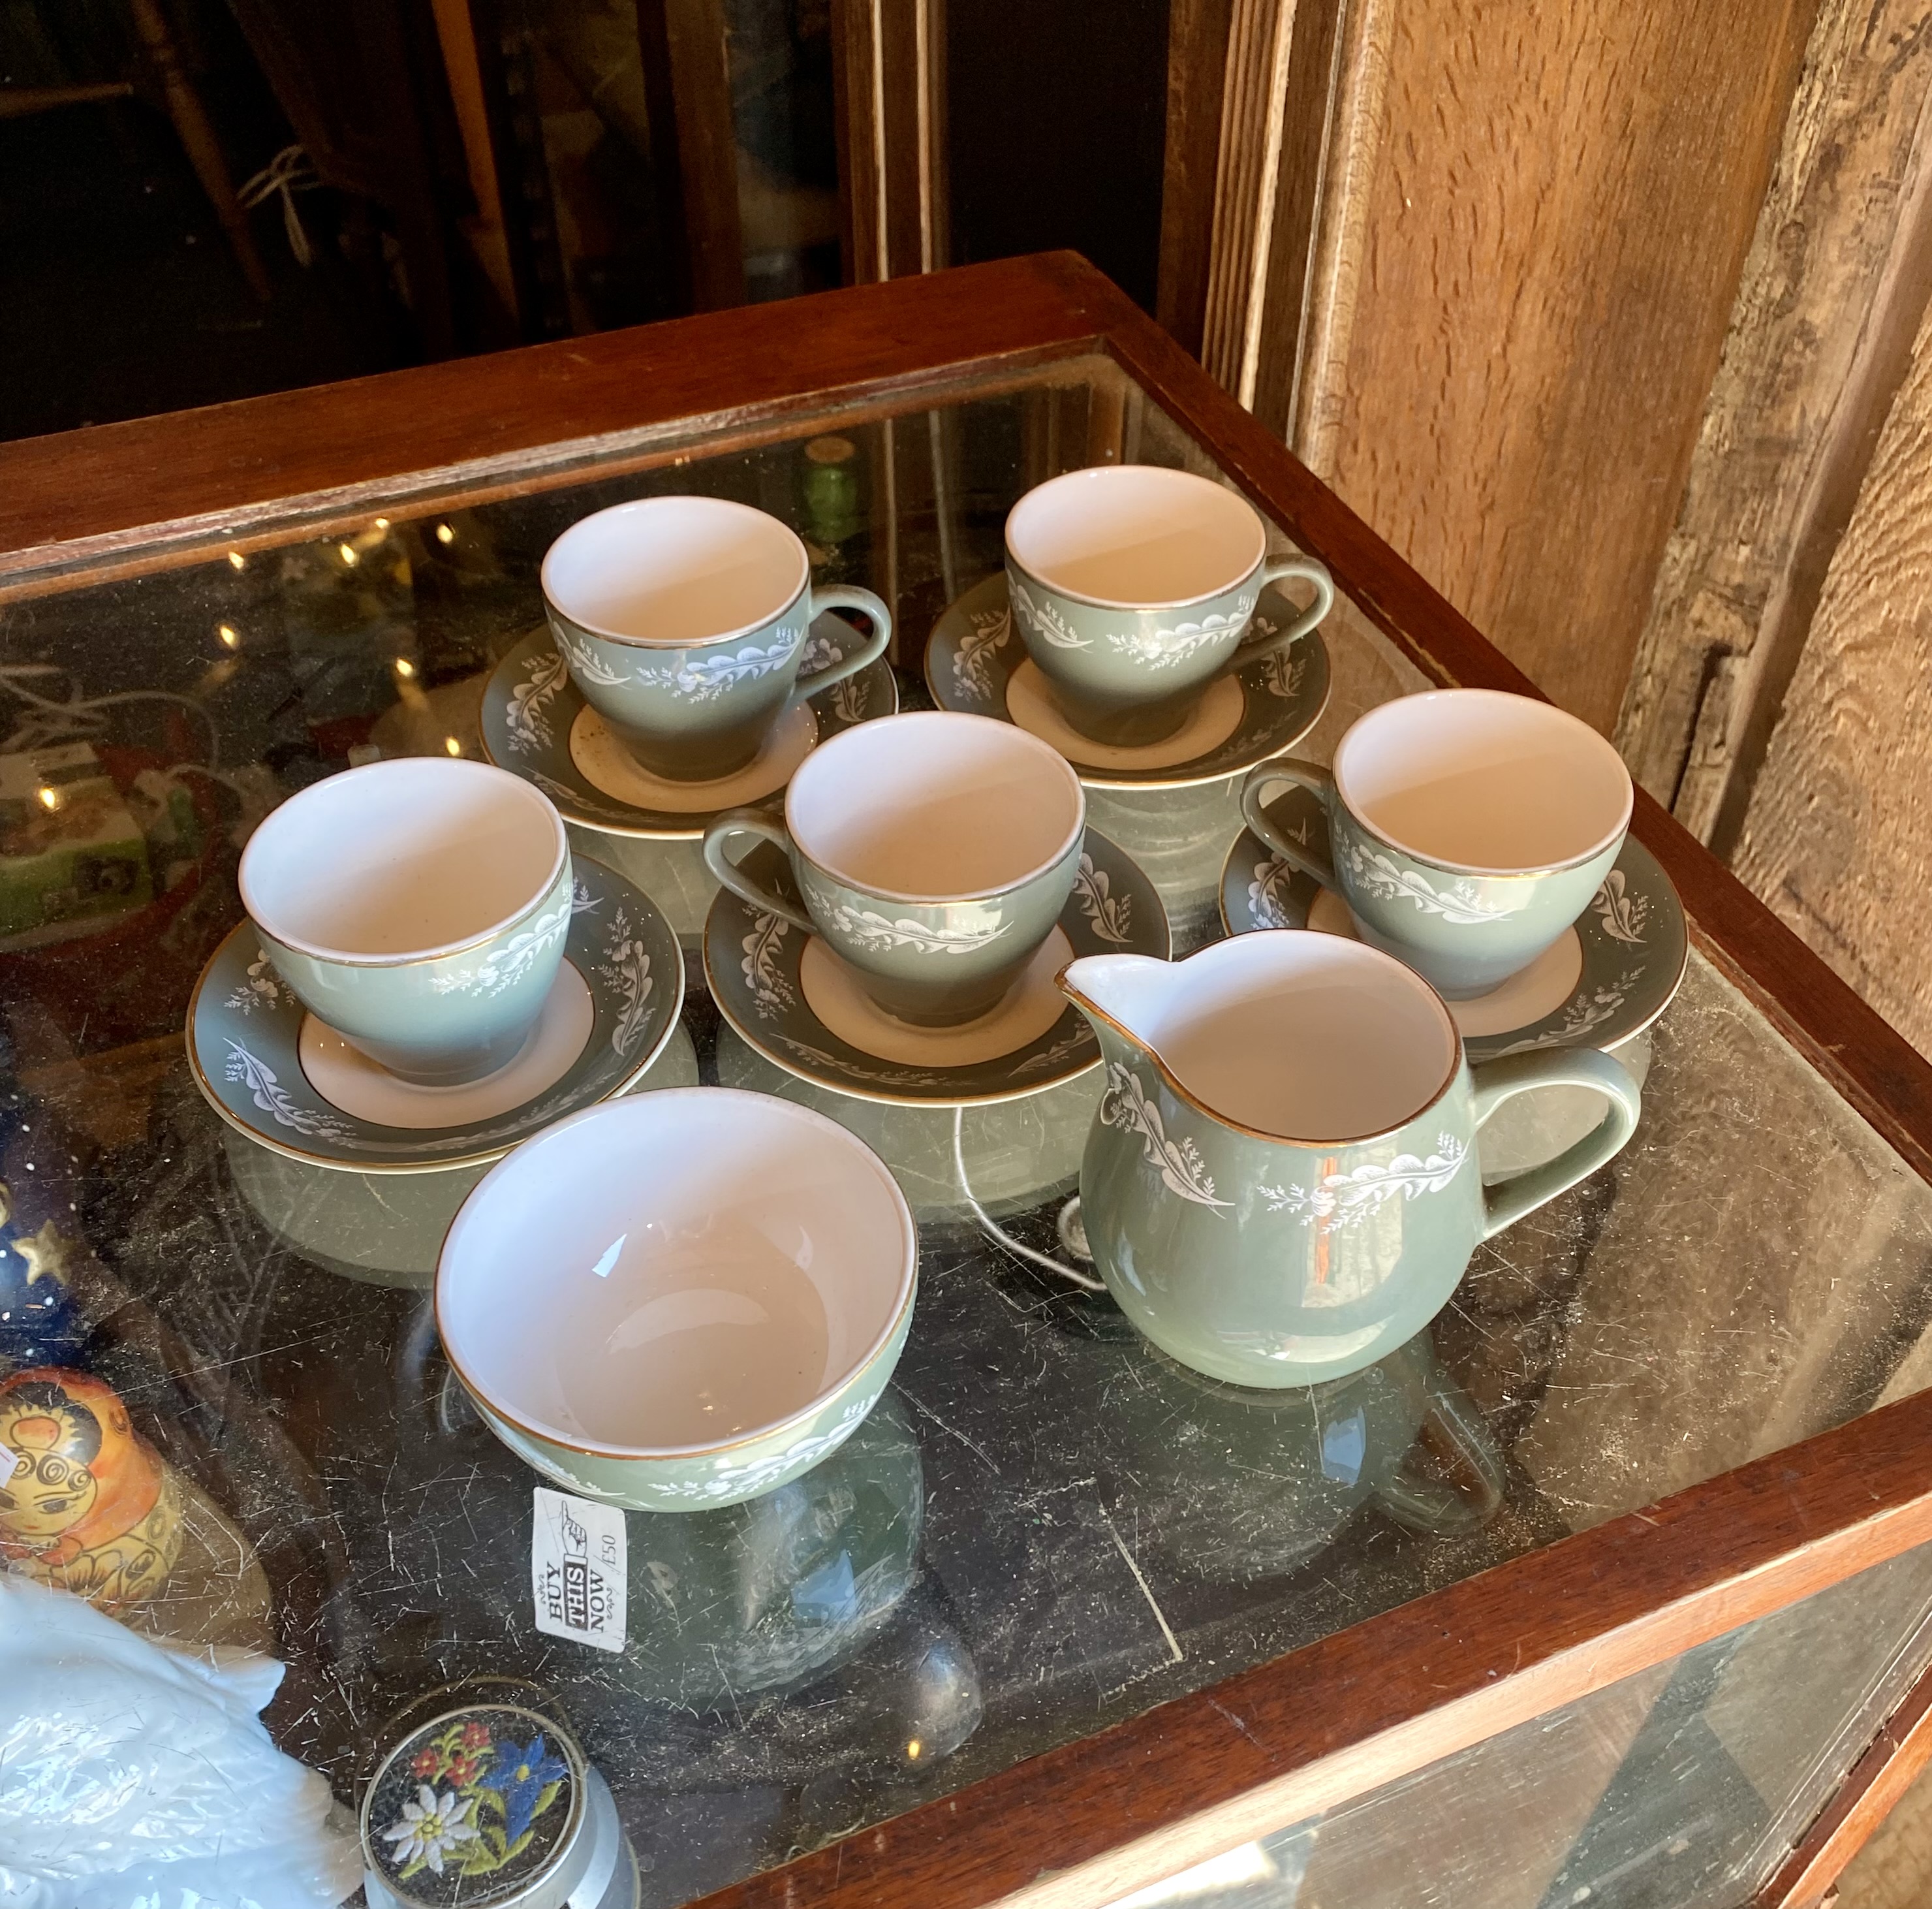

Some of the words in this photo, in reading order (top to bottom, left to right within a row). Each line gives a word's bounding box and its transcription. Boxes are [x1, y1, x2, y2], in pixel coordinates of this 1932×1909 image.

[602, 1535, 616, 1565] £50
[547, 1561, 563, 1622] BUY
[567, 1567, 585, 1625] THIS
[589, 1569, 604, 1632] NOW
